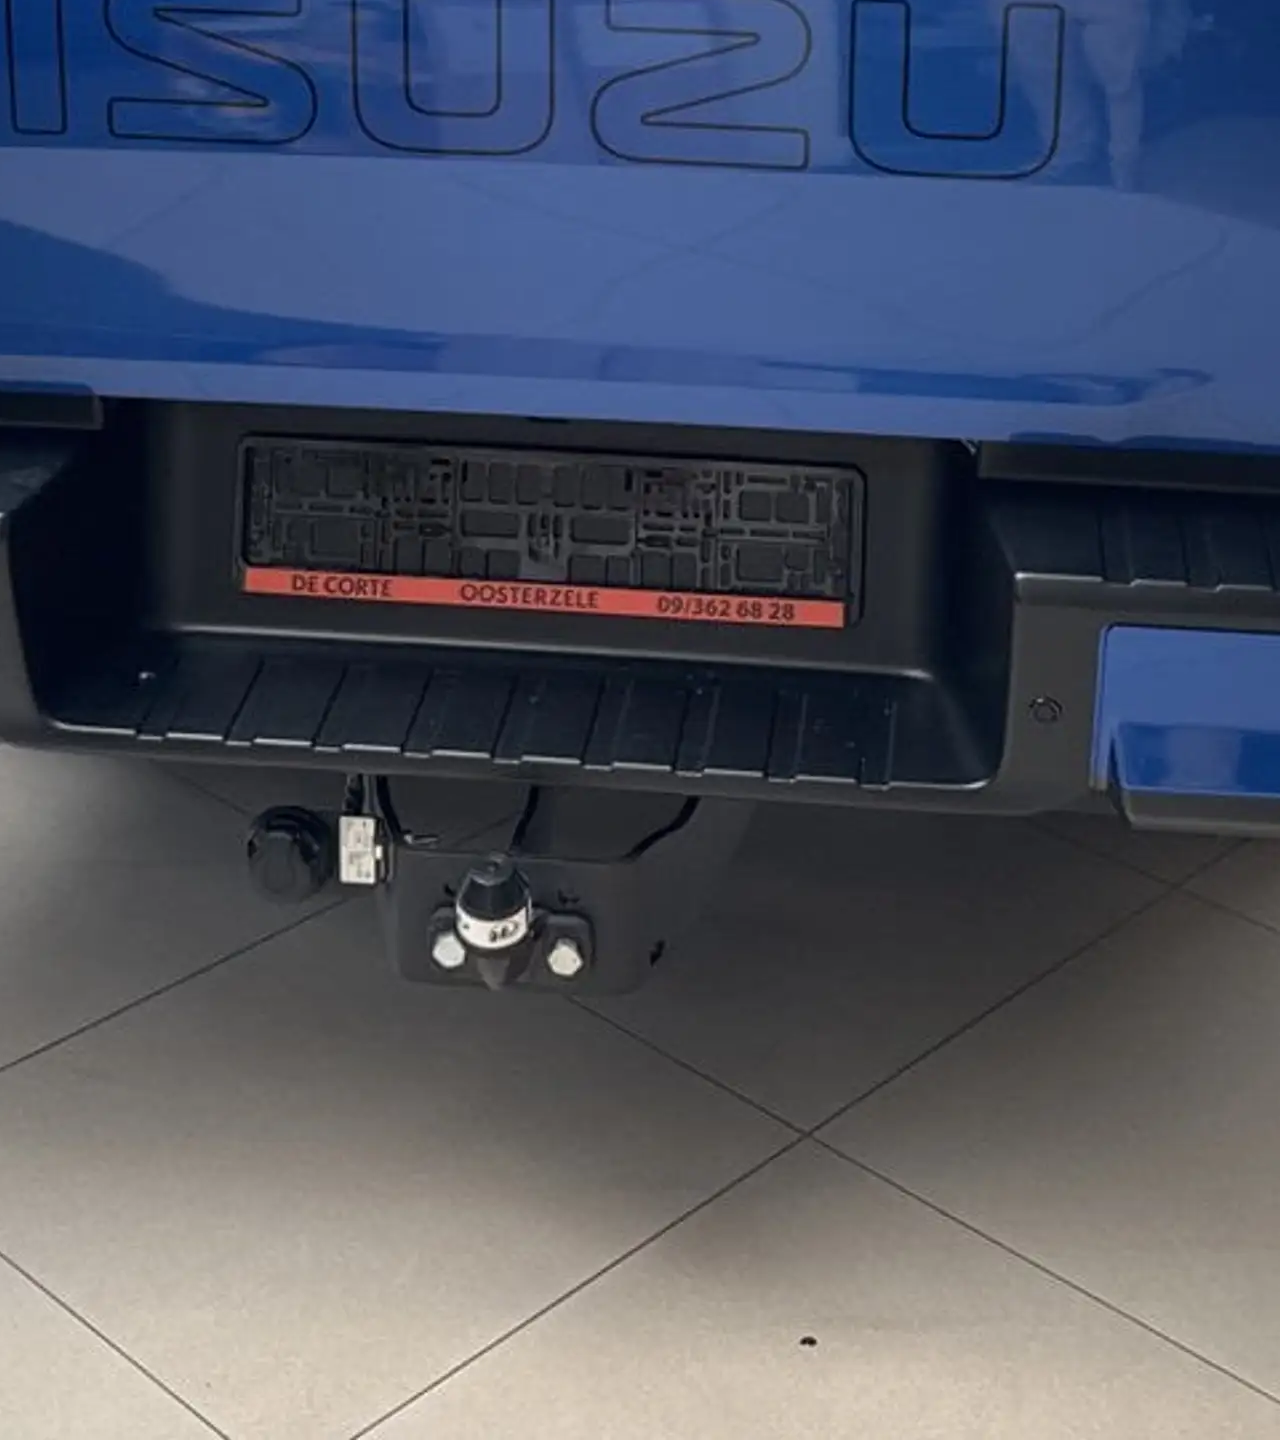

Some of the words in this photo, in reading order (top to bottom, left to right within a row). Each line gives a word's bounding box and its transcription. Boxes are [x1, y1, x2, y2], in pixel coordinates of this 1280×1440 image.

[291, 574, 318, 592] DE
[322, 576, 393, 597] CORTE
[460, 584, 600, 610] OOSTERZELE
[656, 595, 731, 617] 09/362
[736, 601, 762, 619] 68
[768, 603, 795, 621] 28
